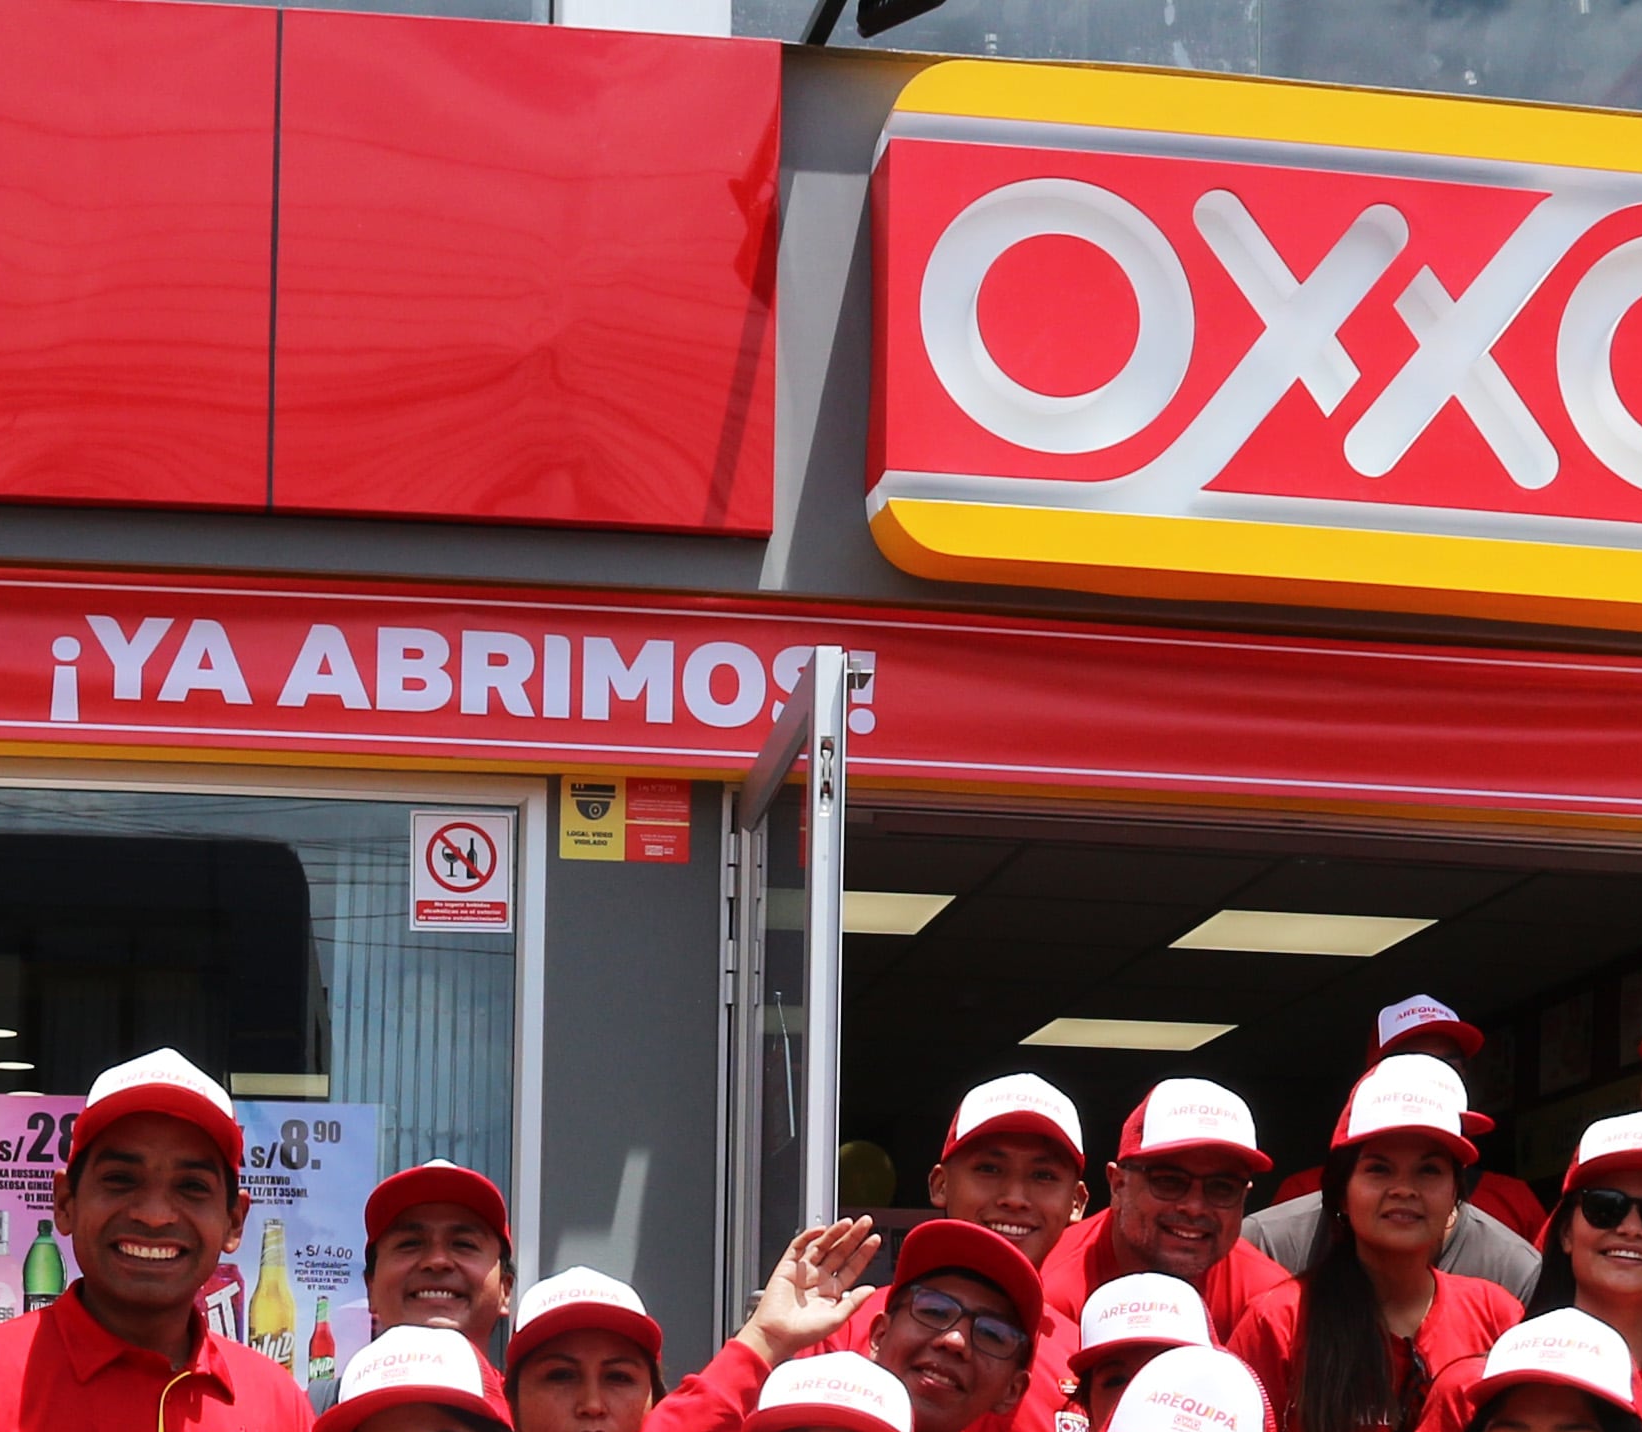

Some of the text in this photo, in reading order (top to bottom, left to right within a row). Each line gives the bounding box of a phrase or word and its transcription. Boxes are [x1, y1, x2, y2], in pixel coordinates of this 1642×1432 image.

[49, 614, 252, 722] ¡YA
[248, 1175, 291, 1186] CARTAVIO
[324, 1245, 353, 1260] 4.00
[1097, 1300, 1182, 1323] AREQUIPA
[1506, 1336, 1603, 1358] AREQUIPA
[352, 1351, 446, 1385] AREQUIPA
[788, 1376, 886, 1408] AREQUIPA
[1145, 1390, 1238, 1432] AREQUIPA
